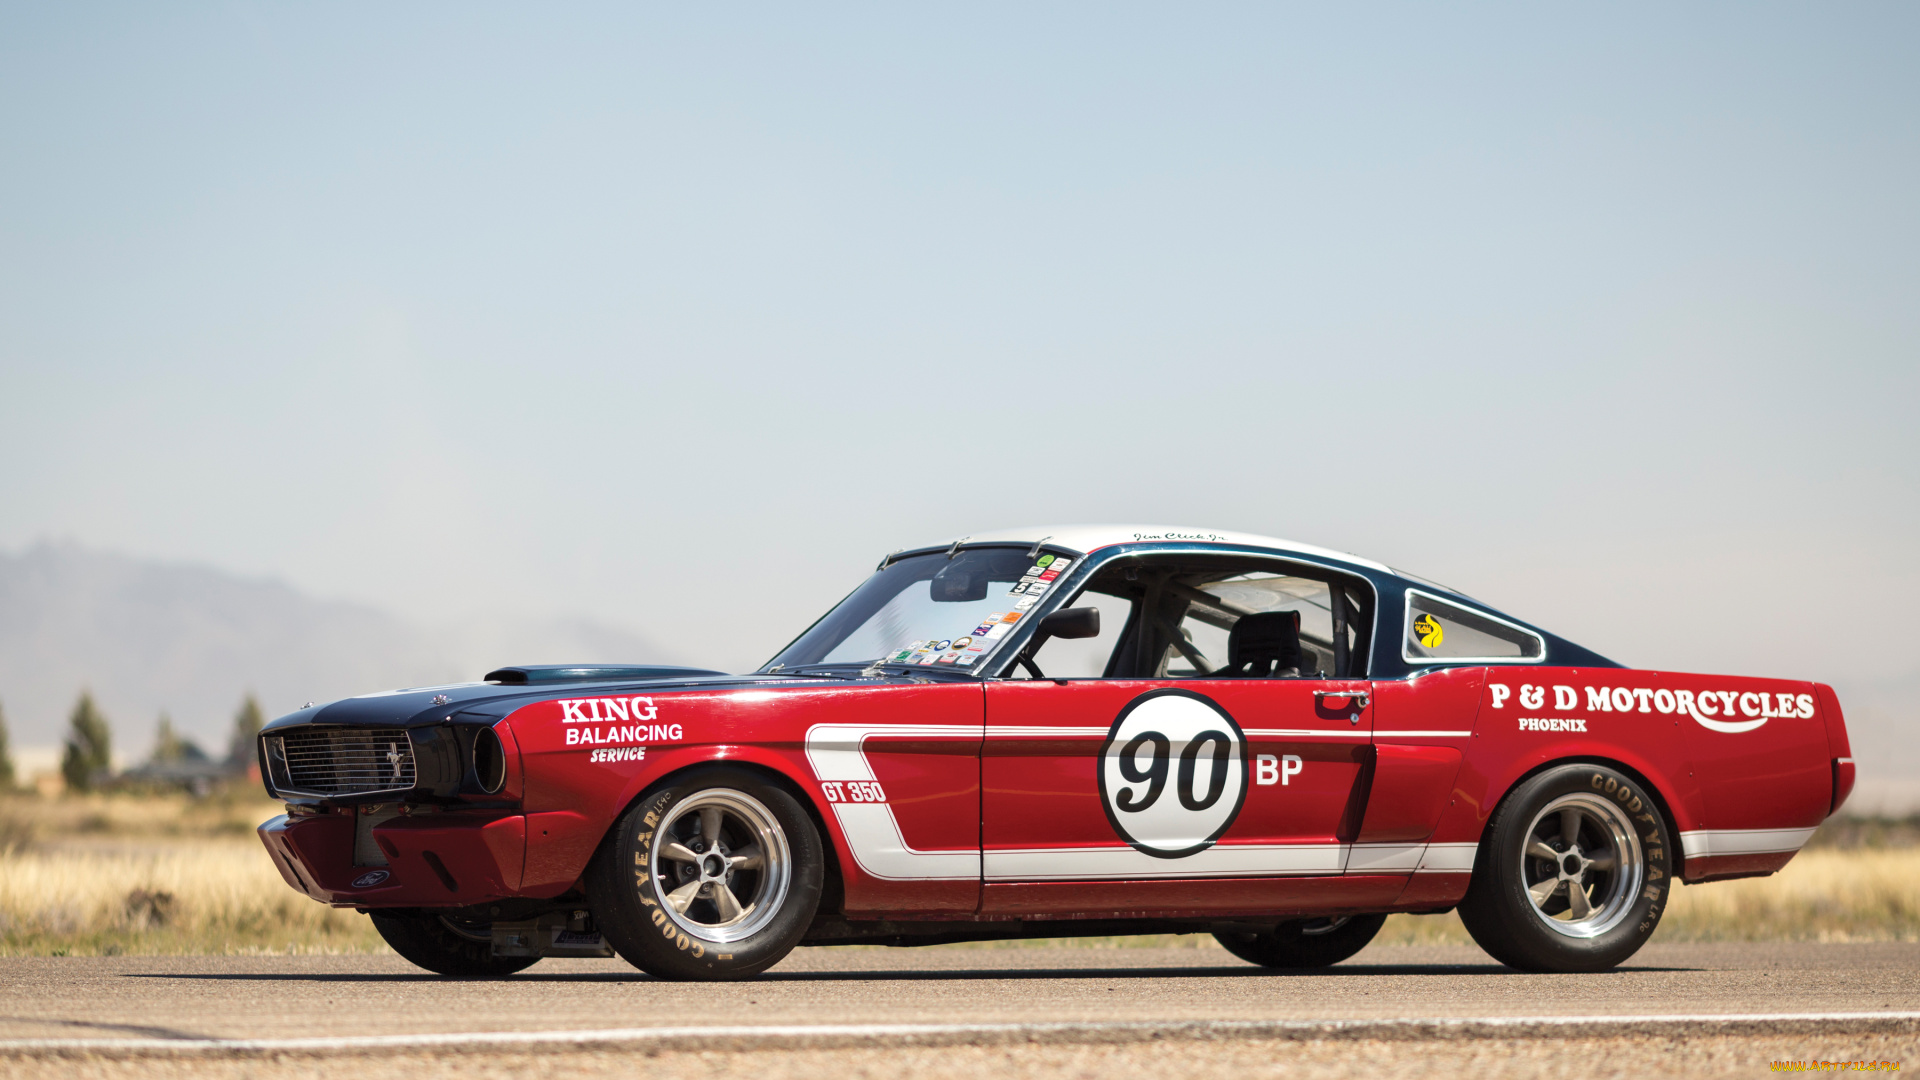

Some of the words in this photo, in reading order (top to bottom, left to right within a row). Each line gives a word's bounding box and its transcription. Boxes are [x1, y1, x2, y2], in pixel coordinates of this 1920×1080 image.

[1133, 533, 1162, 541] Jim
[558, 696, 658, 723] KING
[1488, 683, 1511, 709] P
[1519, 683, 1545, 710] &
[1552, 685, 1578, 710] D
[1584, 686, 1815, 734] MOTORCYCLES
[566, 724, 683, 745] BALANCING
[1518, 718, 1587, 732] PHOENIX
[590, 746, 646, 763] SERVICE
[1116, 730, 1231, 813] 90
[1256, 754, 1303, 786] BP
[821, 782, 847, 802] GT
[847, 782, 887, 802] 350
